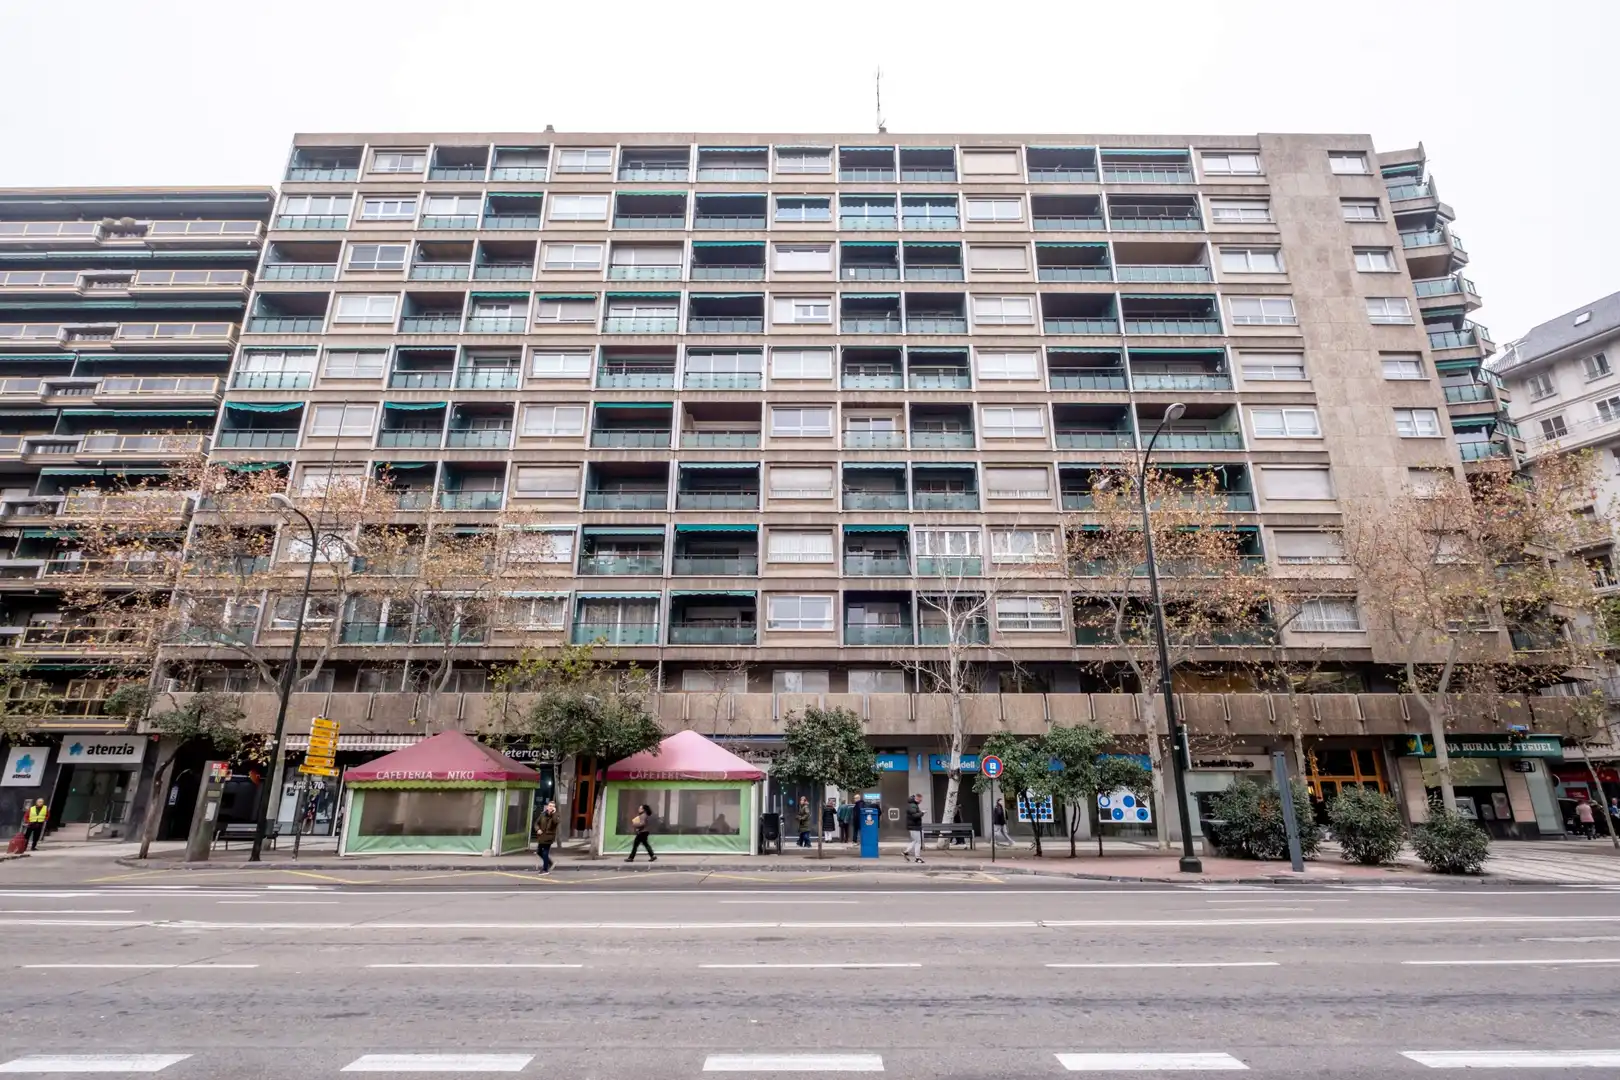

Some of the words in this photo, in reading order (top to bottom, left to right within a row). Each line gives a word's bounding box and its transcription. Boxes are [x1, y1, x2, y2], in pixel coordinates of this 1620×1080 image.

[86, 743, 135, 755] atenzia
[1446, 743, 1460, 752] AJA
[1462, 743, 1497, 752] RURAL
[1500, 743, 1512, 752] DE
[1515, 743, 1555, 752] TERUEL
[941, 760, 975, 769] Sadell
[376, 771, 433, 780] CAFETERIA
[447, 770, 475, 780] NIKO
[629, 770, 684, 780] CAFETERI
